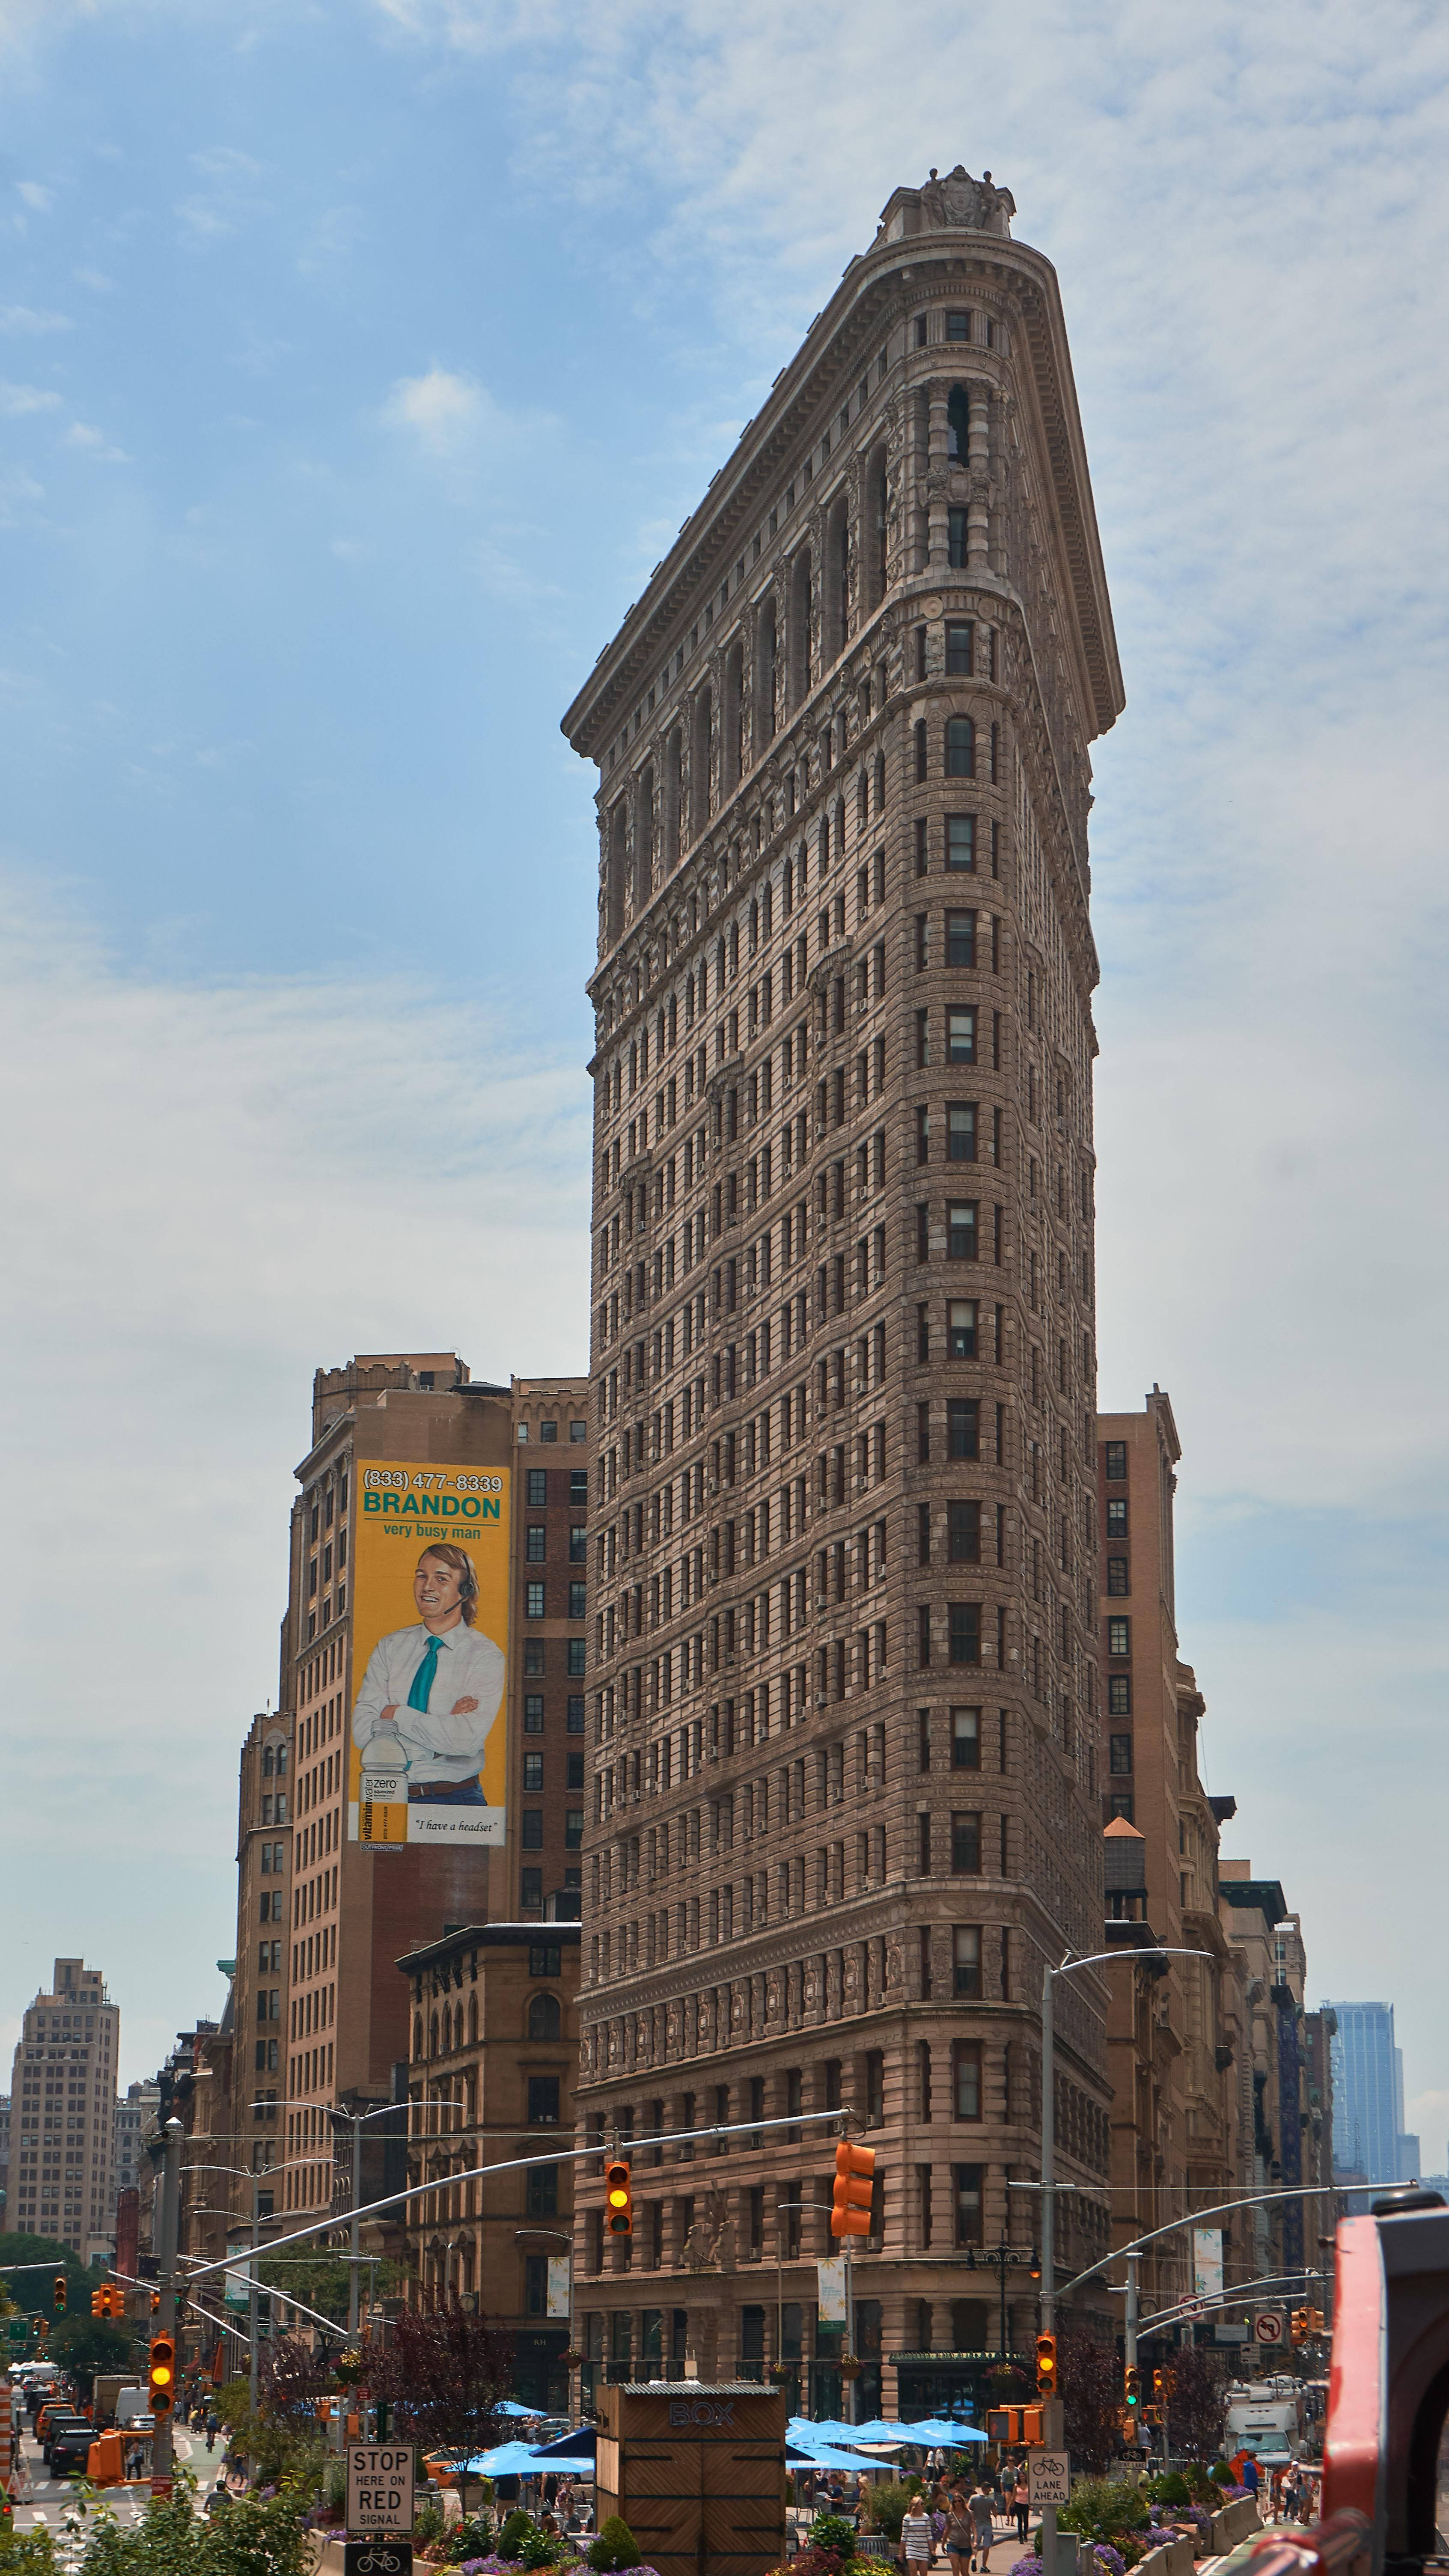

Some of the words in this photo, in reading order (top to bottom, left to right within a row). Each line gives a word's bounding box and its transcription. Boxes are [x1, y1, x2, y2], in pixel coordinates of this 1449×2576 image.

[363, 1469, 409, 1491] (833)
[411, 1472, 503, 1493] 477-8339
[364, 1491, 500, 1519] BRANDON
[384, 1524, 412, 1538] very
[416, 1523, 448, 1540] busy
[452, 1528, 480, 1539] man
[374, 1779, 397, 1789] zero
[426, 1820, 447, 1830] have
[669, 2402, 734, 2425] BOX
[354, 2452, 408, 2471] STOP
[356, 2476, 384, 2486] HERE
[390, 2476, 405, 2486] ON
[1037, 2481, 1061, 2489] LANE
[359, 2490, 401, 2510] RED
[1034, 2492, 1065, 2500] AHEAD
[360, 2514, 400, 2525] SIGNAL
